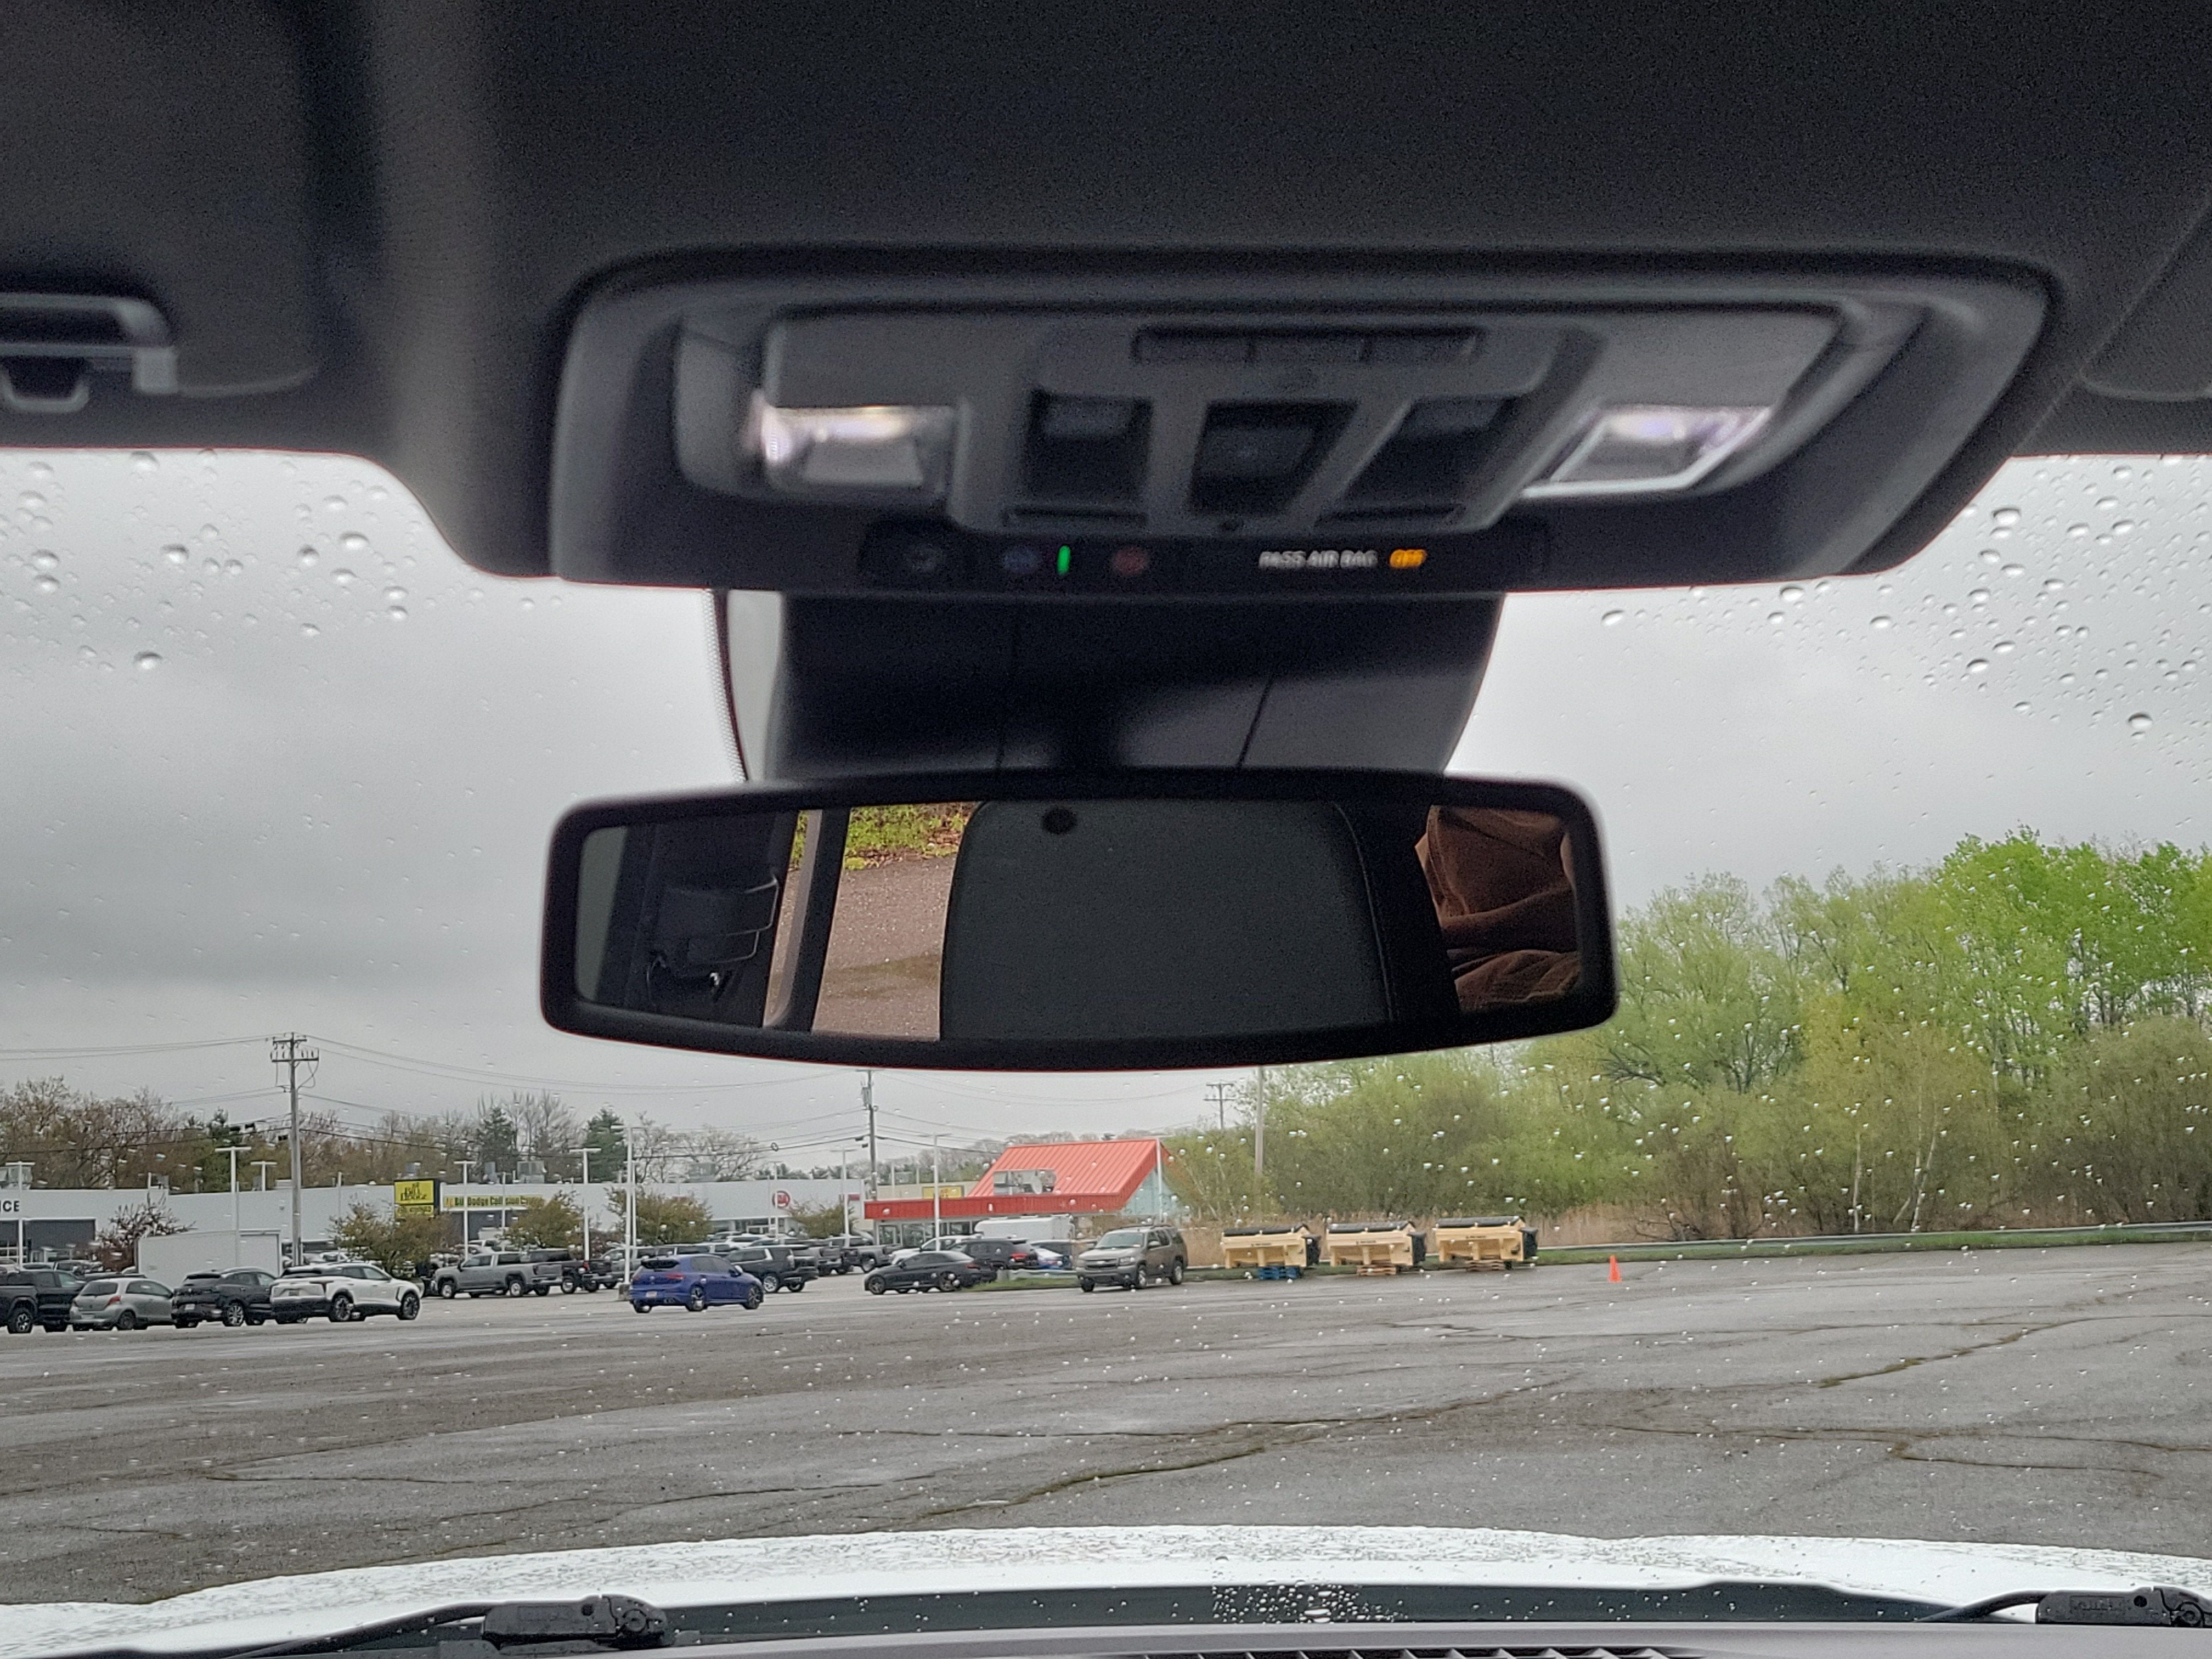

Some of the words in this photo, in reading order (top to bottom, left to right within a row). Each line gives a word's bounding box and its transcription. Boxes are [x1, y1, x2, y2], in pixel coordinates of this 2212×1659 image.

[1259, 551, 1306, 568] PASS
[1307, 550, 1339, 567] AIR
[1390, 549, 1426, 568] OFF
